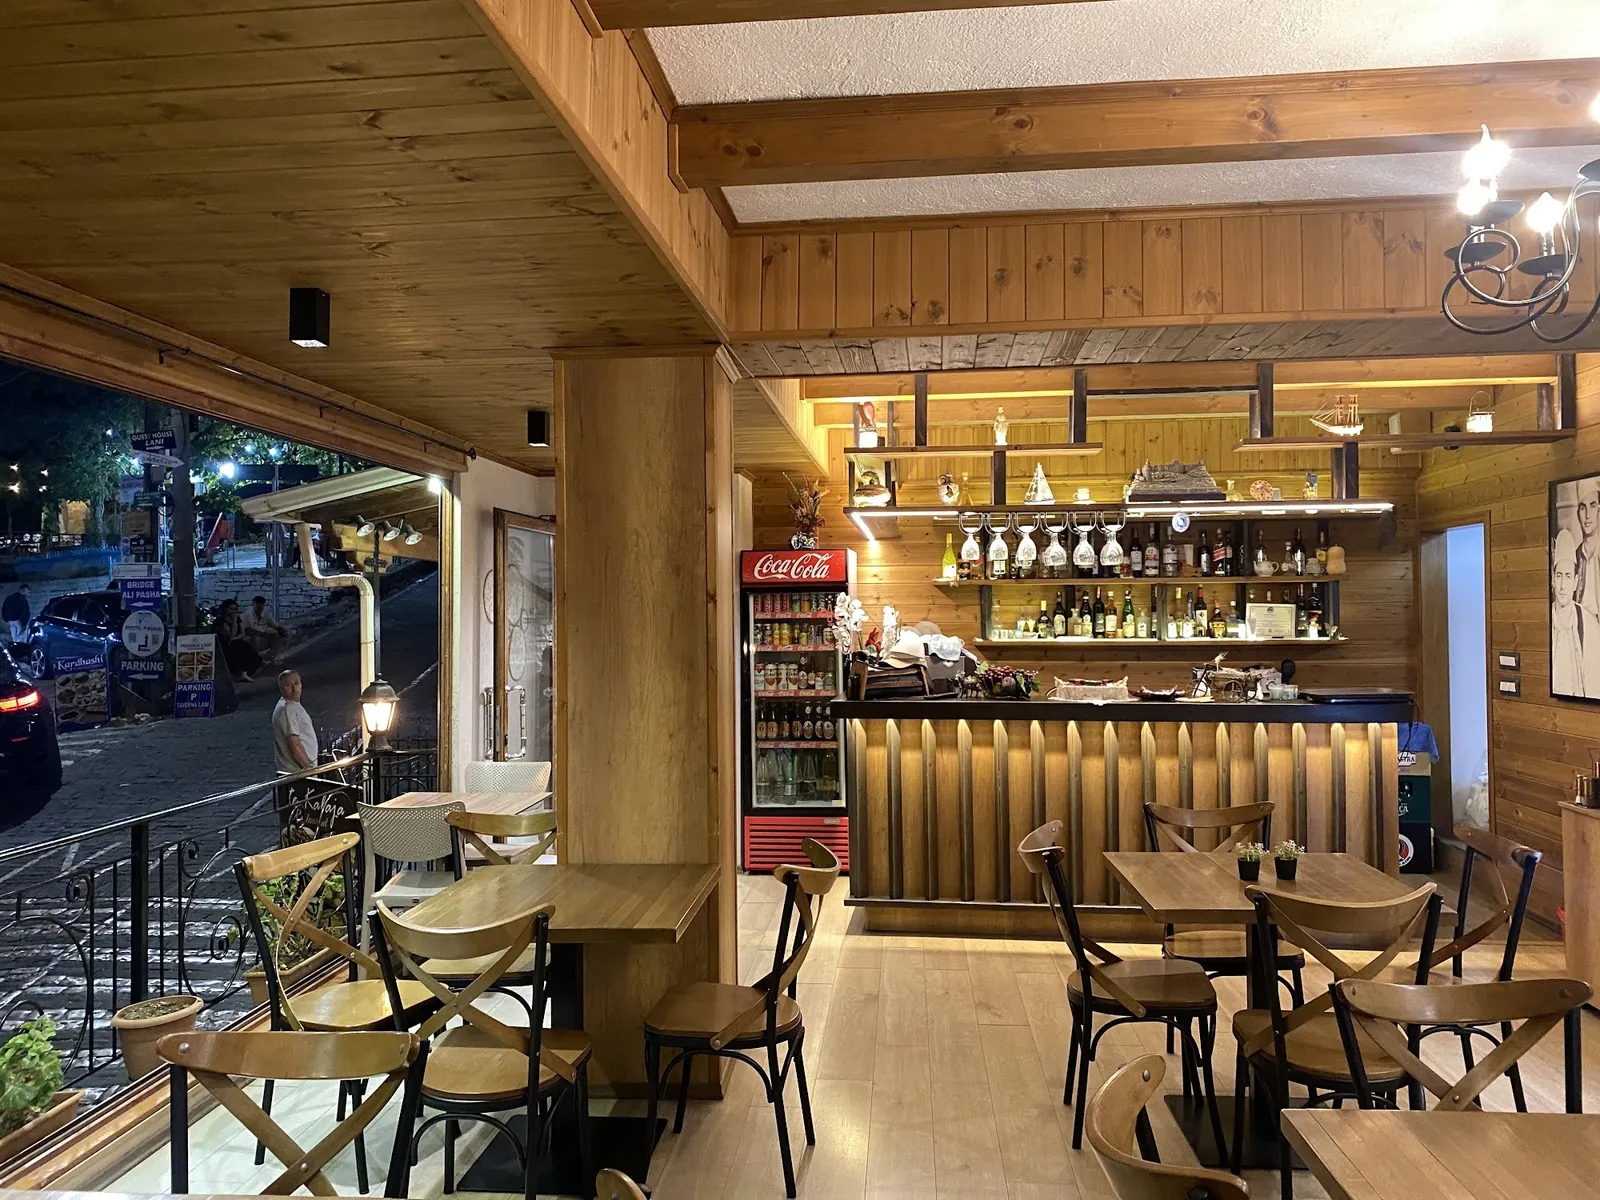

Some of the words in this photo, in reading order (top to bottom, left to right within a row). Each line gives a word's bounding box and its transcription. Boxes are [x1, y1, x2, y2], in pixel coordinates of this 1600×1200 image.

[152, 431, 173, 439] HOUSE
[145, 439, 164, 447] LANI
[753, 553, 834, 580] Coca-Cola
[127, 581, 155, 589] BRIDGE
[122, 591, 135, 599] ALI
[136, 591, 161, 599] PASHA
[57, 654, 104, 672] Kardhashi
[121, 661, 164, 671] PARKING
[177, 683, 211, 692] PARKING
[190, 693, 197, 701] P
